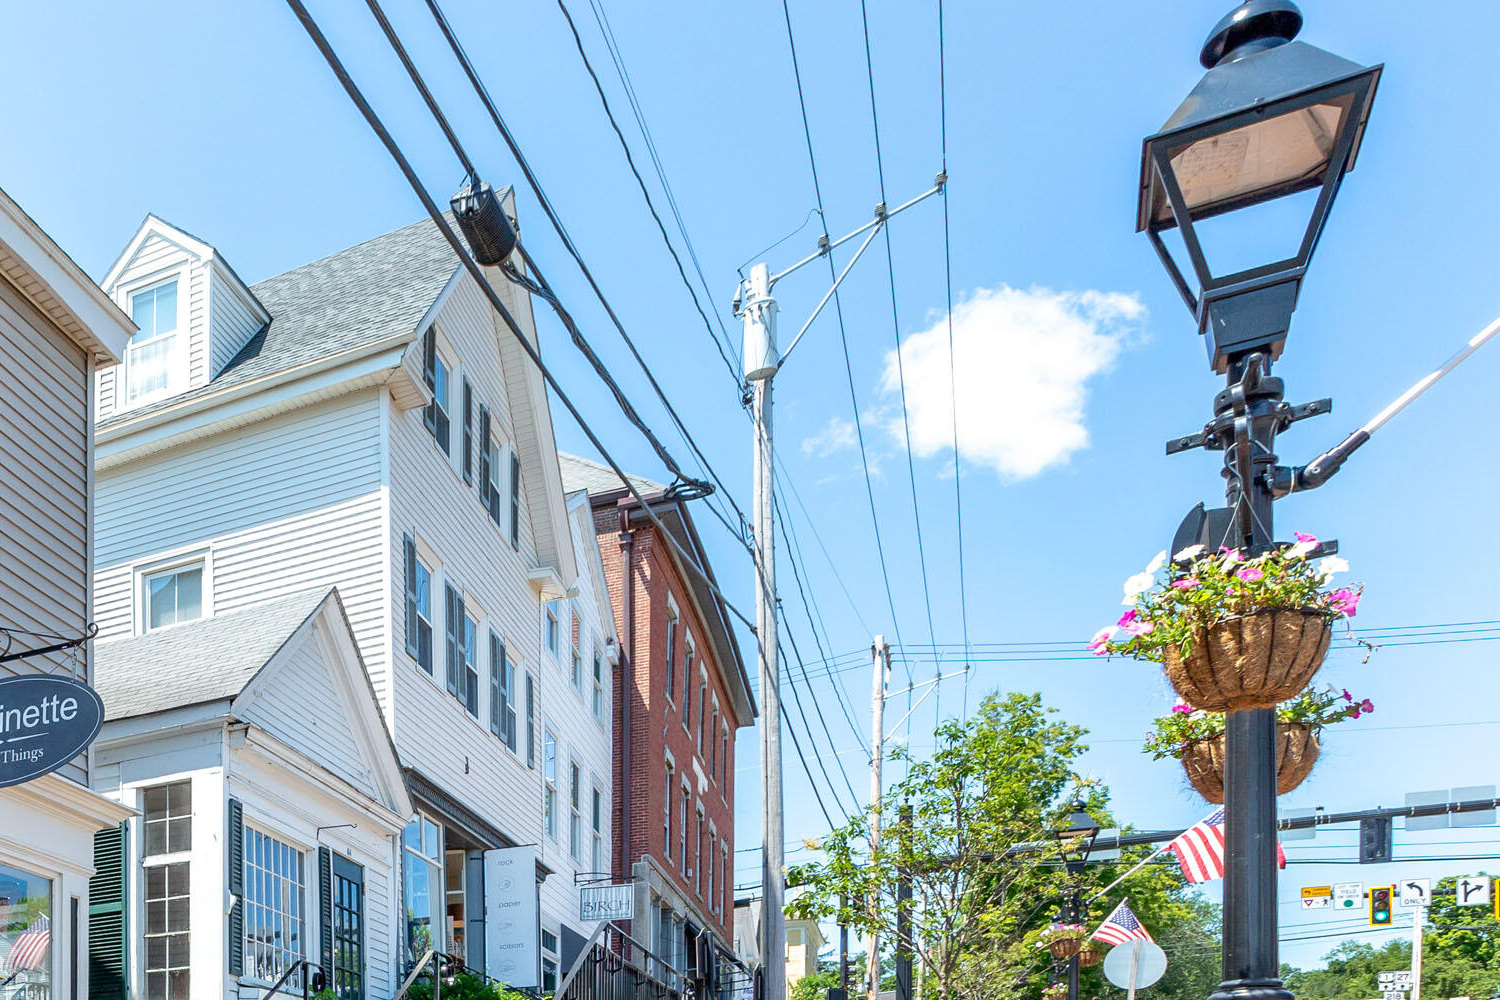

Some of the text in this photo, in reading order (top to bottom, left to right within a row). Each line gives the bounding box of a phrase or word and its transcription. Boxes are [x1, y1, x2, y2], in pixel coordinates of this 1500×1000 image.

[0, 748, 44, 763] Things
[499, 901, 521, 909] paper
[584, 899, 630, 912] BIRCH
[499, 942, 525, 950] scissors
[1386, 993, 1402, 1000] 218
